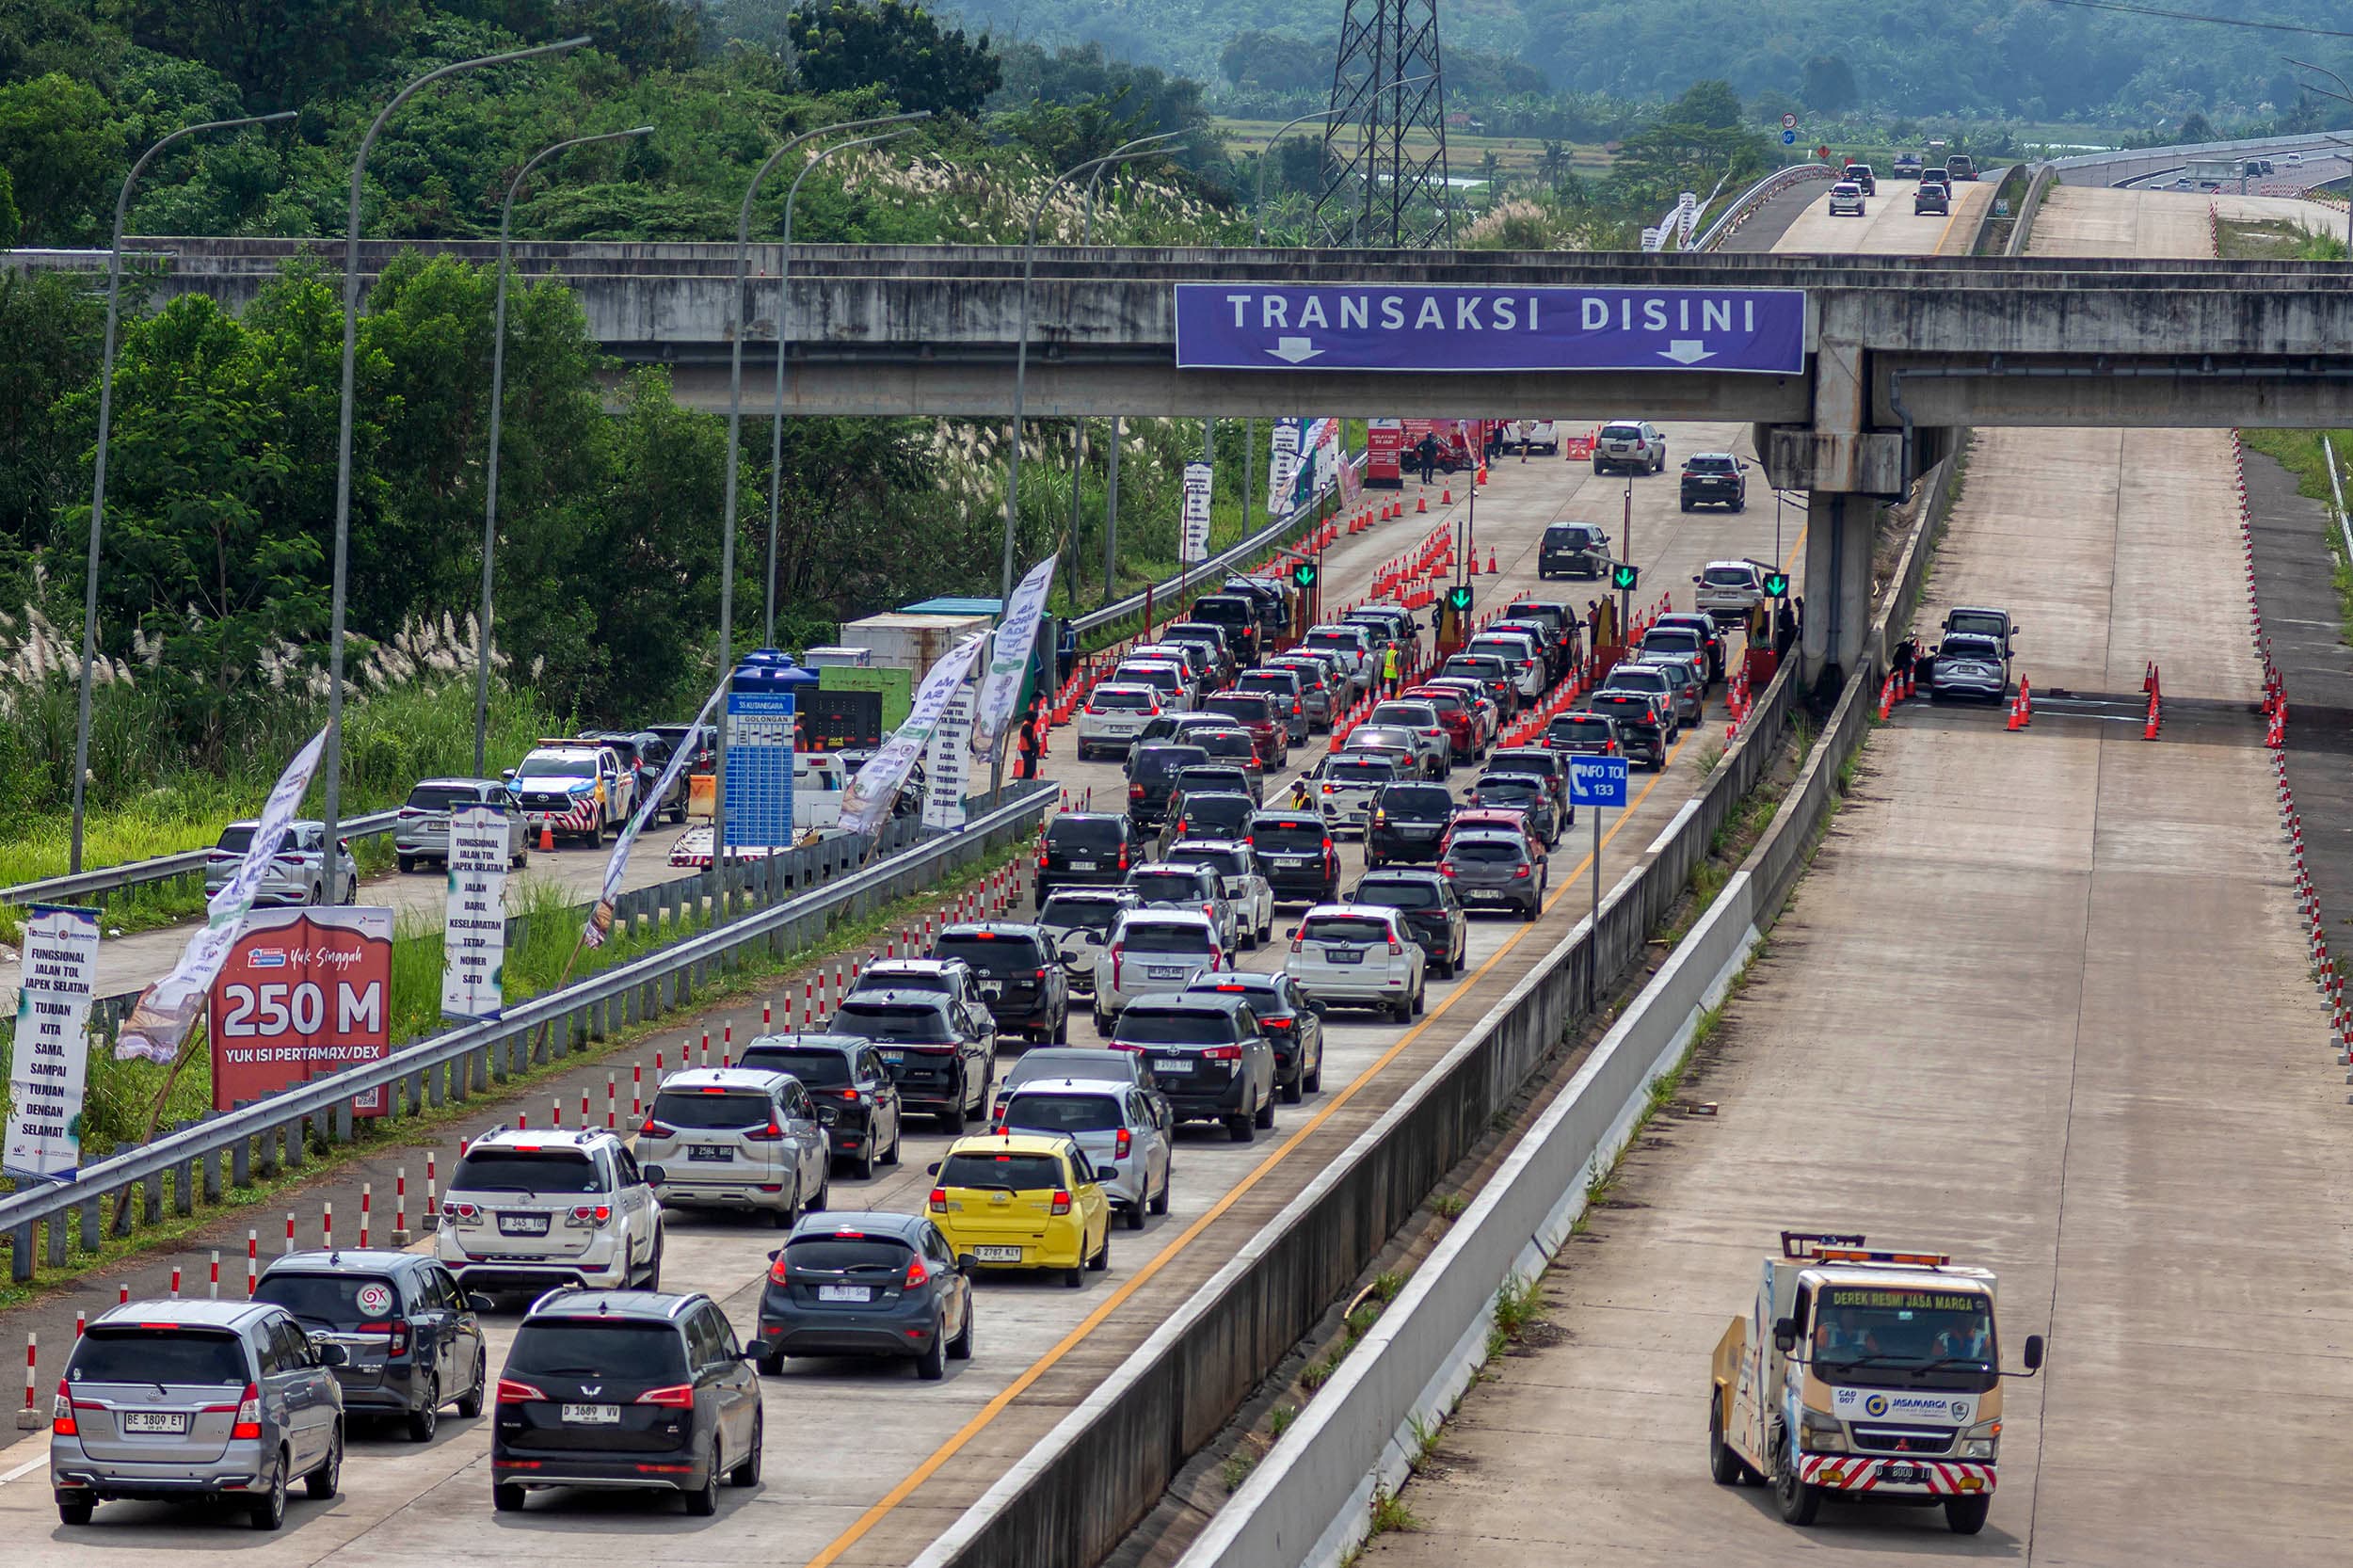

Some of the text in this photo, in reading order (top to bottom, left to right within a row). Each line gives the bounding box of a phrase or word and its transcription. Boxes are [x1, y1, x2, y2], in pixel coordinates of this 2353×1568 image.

[1227, 294, 1755, 332] TRANSAKSI DISINI
[1581, 764, 1626, 779] INFO TOL
[1593, 784, 1614, 796] 133
[456, 838, 499, 849] FUNGSIONAL
[459, 850, 495, 860] JALAN TOL
[452, 861, 504, 872] JAPEK SELATAN
[464, 883, 488, 893] JALAN
[449, 919, 502, 930] KESELAMATAN
[463, 937, 487, 948] TETAP
[31, 948, 85, 964] FUNGSIONAL
[291, 945, 363, 971] Yuk Singgah
[460, 956, 487, 966] NOMER
[35, 964, 79, 978] JALAN TOL
[463, 974, 483, 984] SATU
[24, 978, 89, 994] JAPEK SELATAN
[35, 1001, 72, 1016] TUJUAN
[224, 981, 381, 1037] 250 M
[40, 1023, 61, 1036] KITA
[35, 1043, 65, 1058] SAMA,
[226, 1046, 380, 1063] YUK ISI PERTAMAX/DEX
[30, 1063, 67, 1078] SAMPAI
[29, 1083, 65, 1097] TUJUAN
[26, 1103, 64, 1118] DENGAN
[22, 1123, 64, 1138] SELAMAT
[512, 1218, 527, 1227] 345
[1833, 1291, 1974, 1311] DEREK RESMI JASA MARGA
[1892, 1398, 1947, 1409] JASAMARGA
[564, 1406, 570, 1416] D
[573, 1406, 598, 1416] 1689
[127, 1415, 184, 1426] BE 1809 ET
[1877, 1466, 1883, 1477] D
[1892, 1467, 1913, 1478] 8000
